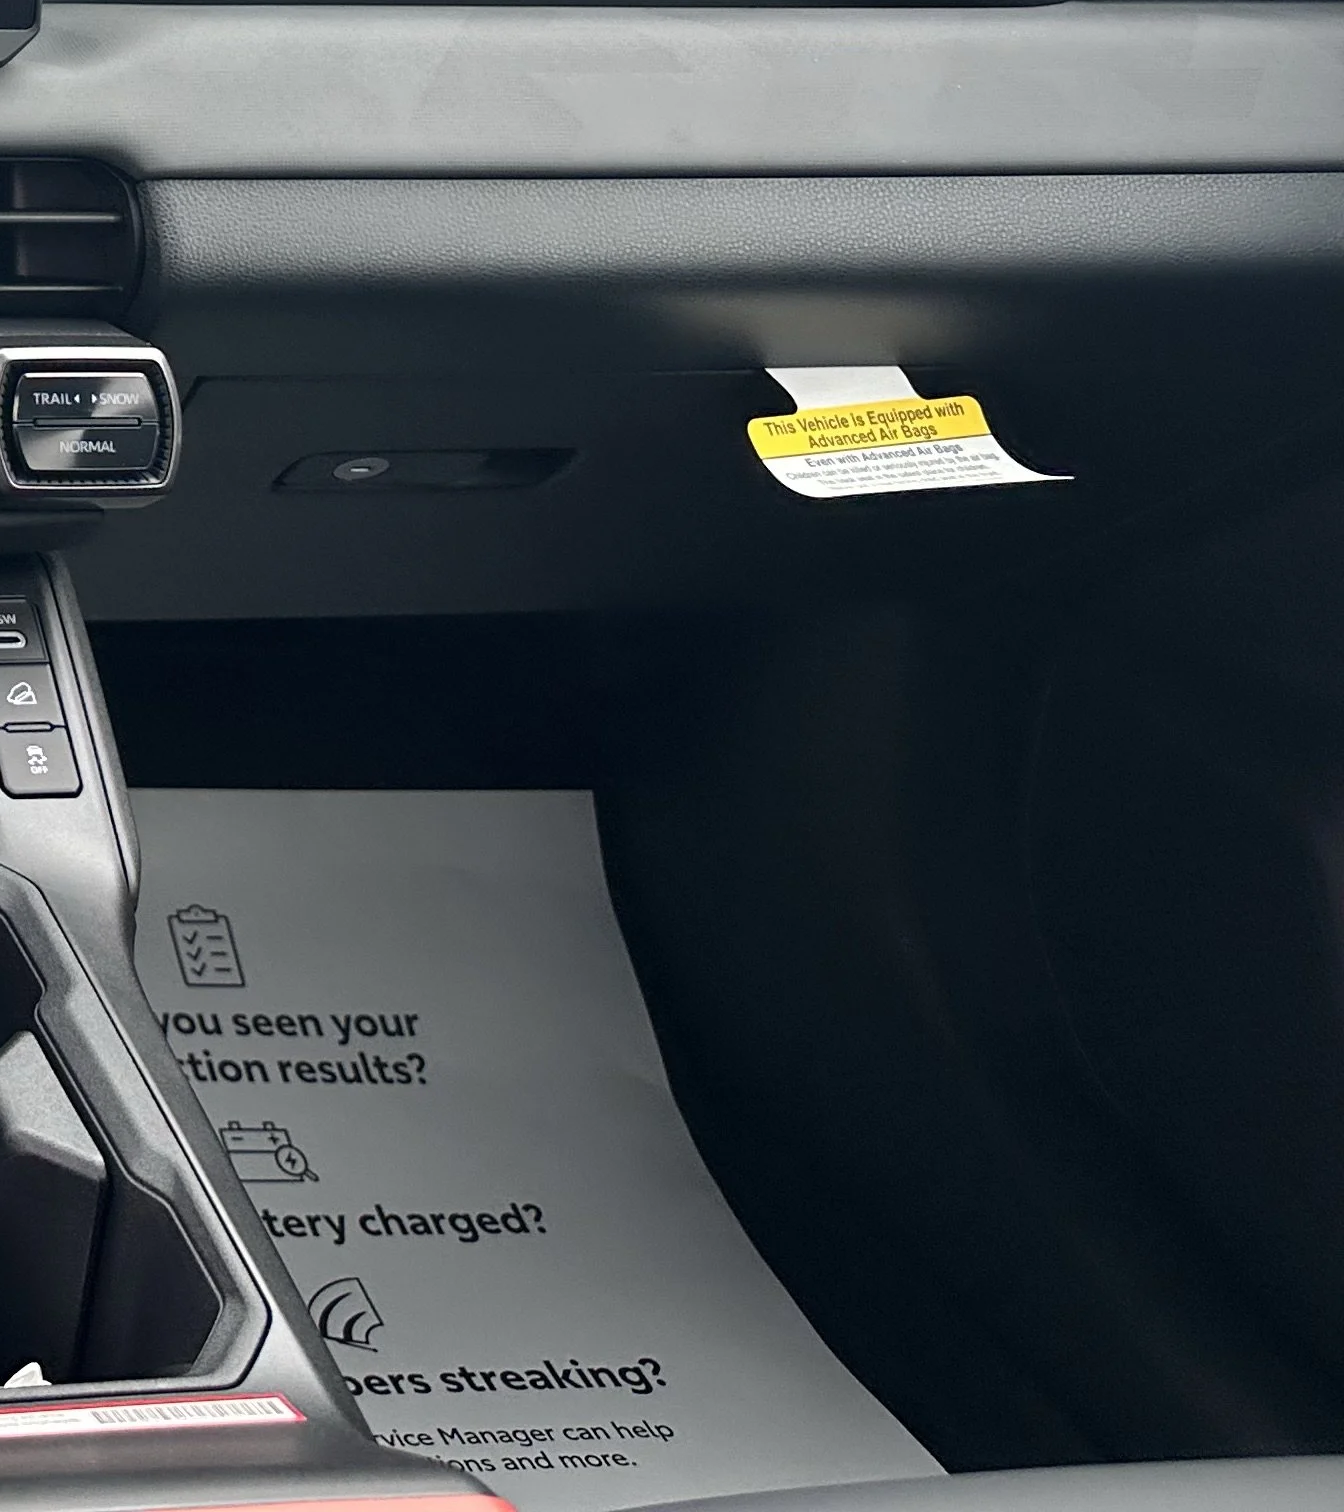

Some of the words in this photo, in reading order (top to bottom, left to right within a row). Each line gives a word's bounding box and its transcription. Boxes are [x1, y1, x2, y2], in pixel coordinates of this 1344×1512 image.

[33, 392, 72, 406] TRAIL
[99, 392, 139, 406] SNOW
[763, 420, 797, 437] This
[796, 414, 849, 433] Vehicle
[849, 412, 865, 427] Is
[866, 405, 933, 429] Equipped
[934, 402, 965, 418] with
[59, 440, 117, 454] NORMAL
[808, 429, 878, 449] Advanced
[879, 427, 899, 441] Air
[900, 424, 938, 439] Bags
[804, 456, 834, 468] Even
[837, 453, 861, 465] with
[862, 447, 916, 462] Advanced
[918, 446, 933, 456] Air
[933, 443, 963, 455] Bags
[30, 765, 48, 775] OFF
[232, 1013, 323, 1037] seen
[331, 1013, 419, 1045] your
[177, 1049, 270, 1083] tion
[278, 1052, 427, 1085] results?
[262, 1208, 345, 1245] tery
[359, 1203, 547, 1244] charged?
[440, 1357, 668, 1394] streaking?
[437, 1427, 555, 1447] Manager
[562, 1426, 610, 1441] can
[610, 1419, 674, 1442] help
[501, 1450, 555, 1471] and
[558, 1452, 637, 1469] more.
